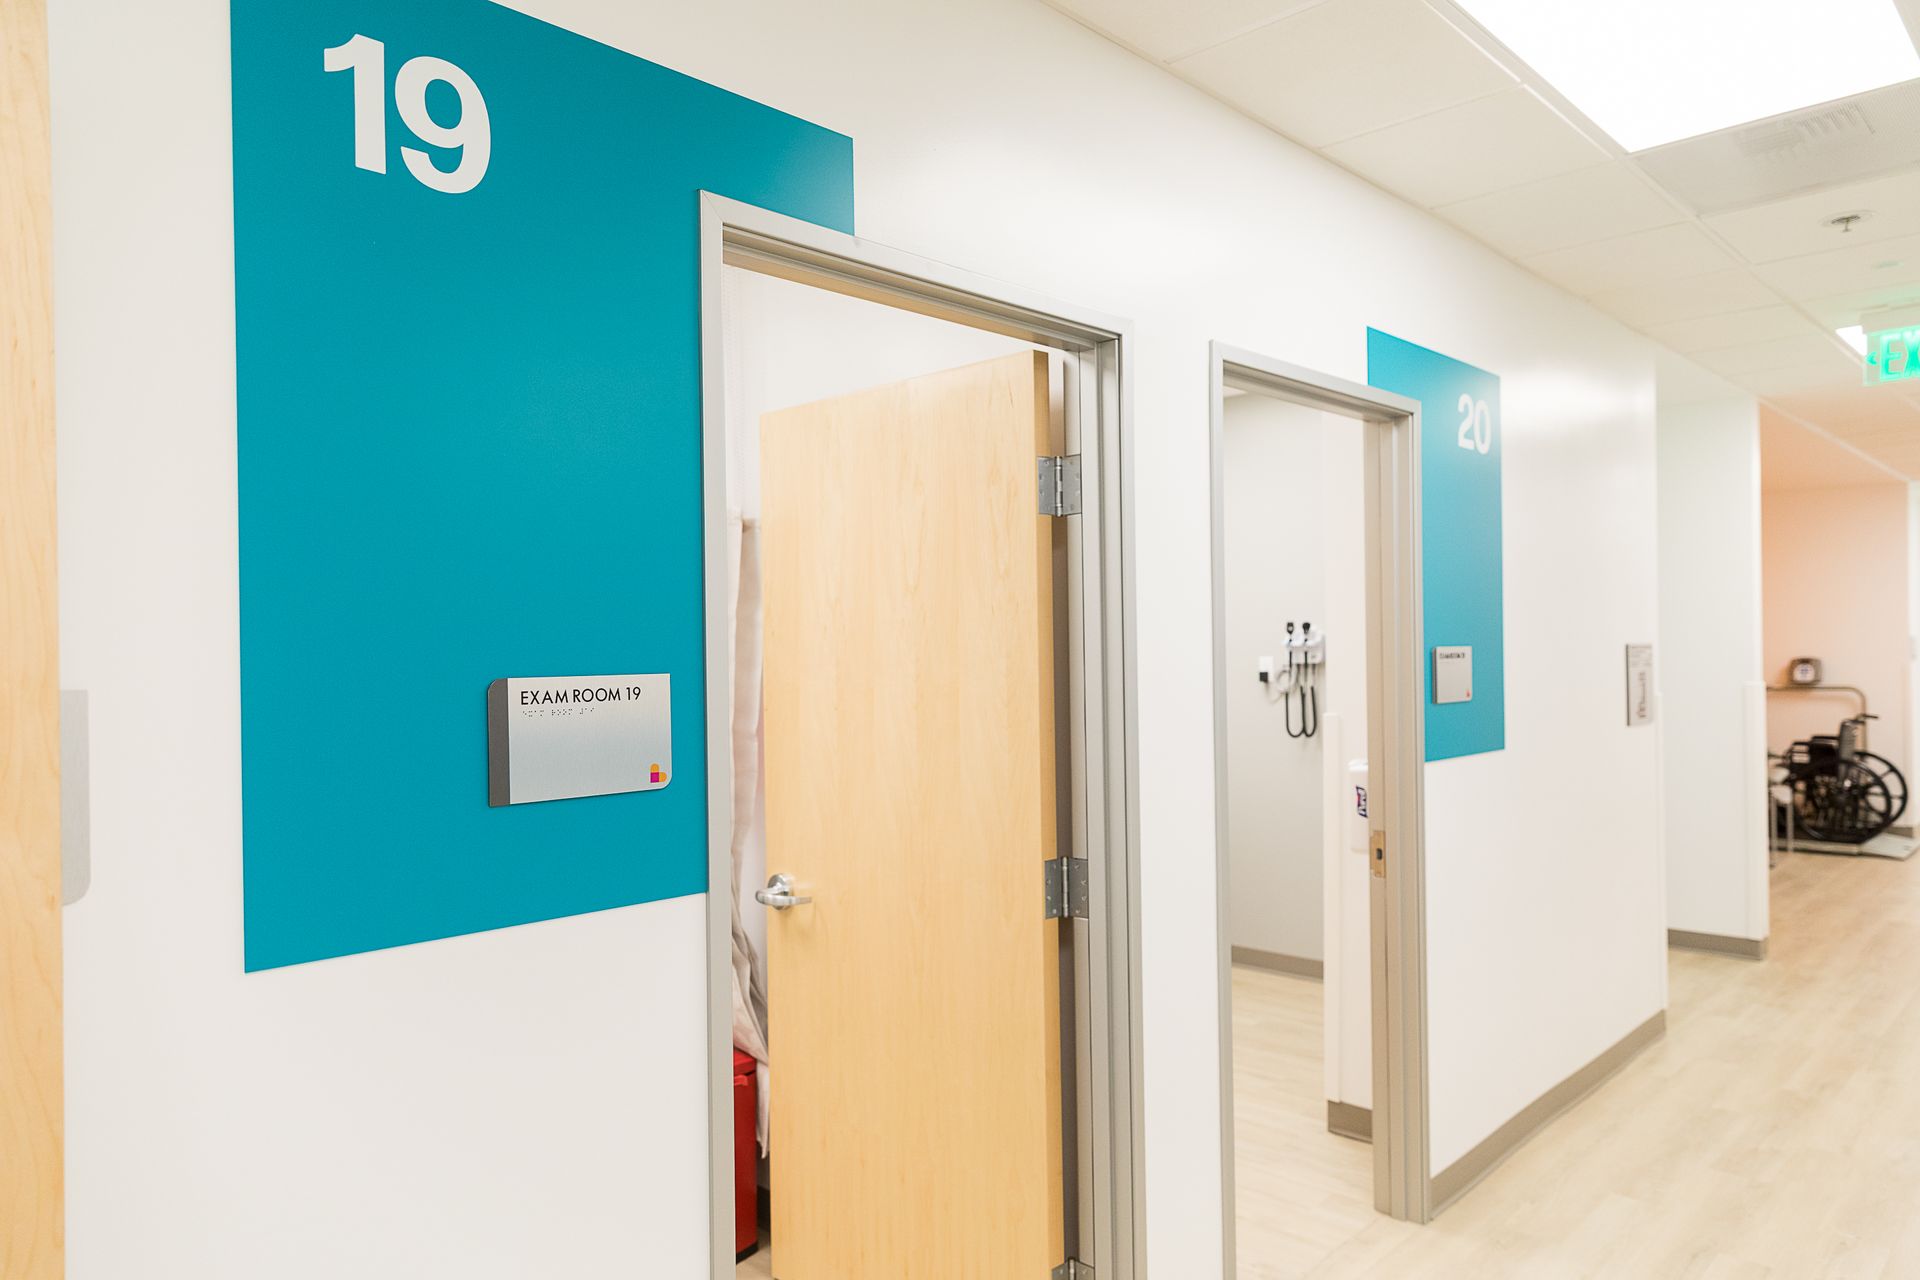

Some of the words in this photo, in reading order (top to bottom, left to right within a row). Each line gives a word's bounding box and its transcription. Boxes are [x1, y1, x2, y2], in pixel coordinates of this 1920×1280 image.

[324, 33, 491, 194] 19
[1458, 393, 1491, 455] 20
[520, 690, 569, 705] EXAM
[572, 688, 621, 703] ROOM
[626, 686, 641, 701] 19
